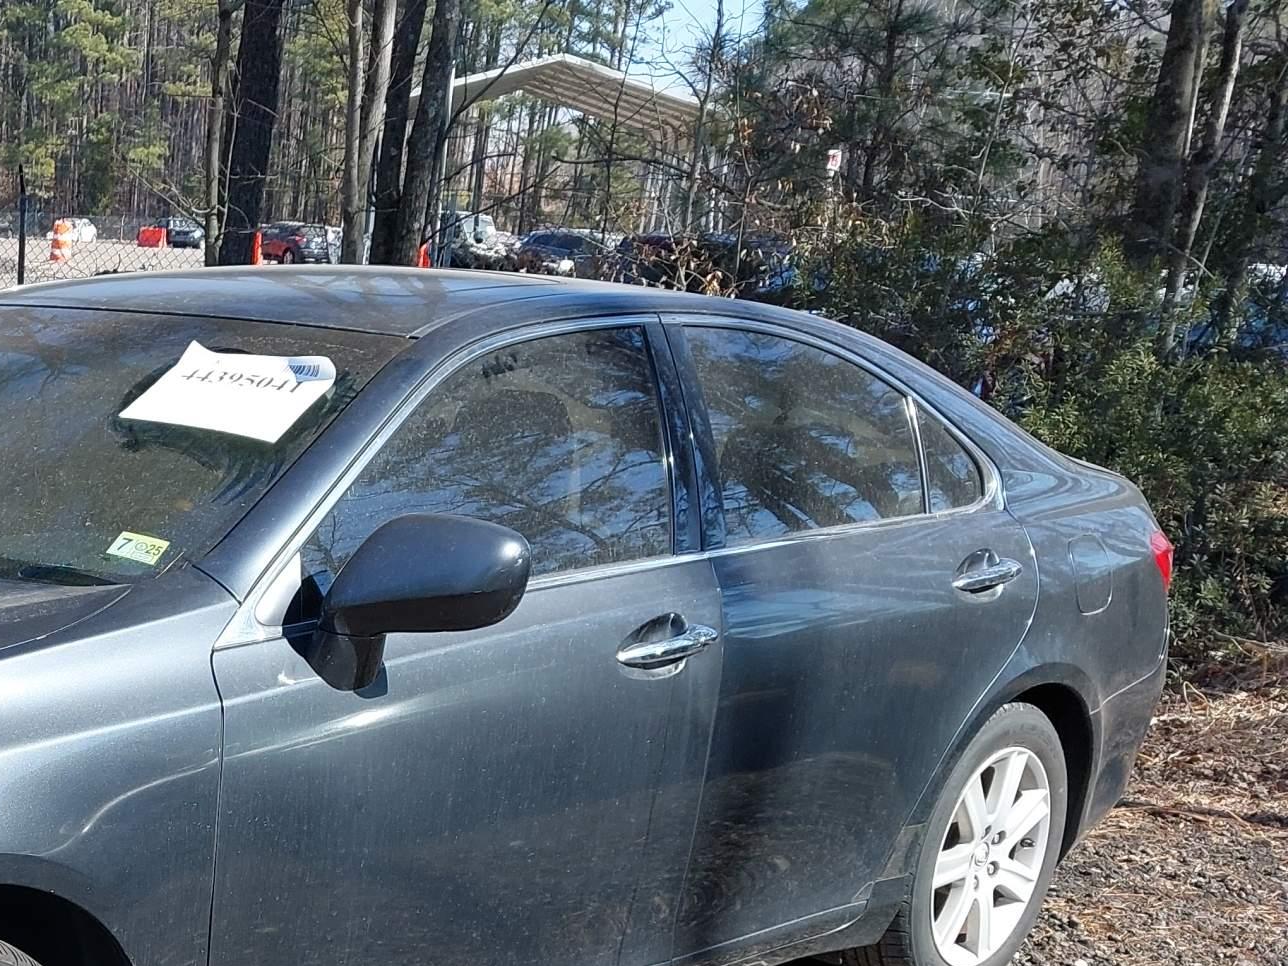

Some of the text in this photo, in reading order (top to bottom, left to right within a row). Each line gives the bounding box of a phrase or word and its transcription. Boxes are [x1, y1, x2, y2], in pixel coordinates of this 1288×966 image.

[181, 368, 304, 393] 44395041
[117, 537, 163, 556] 7 25
